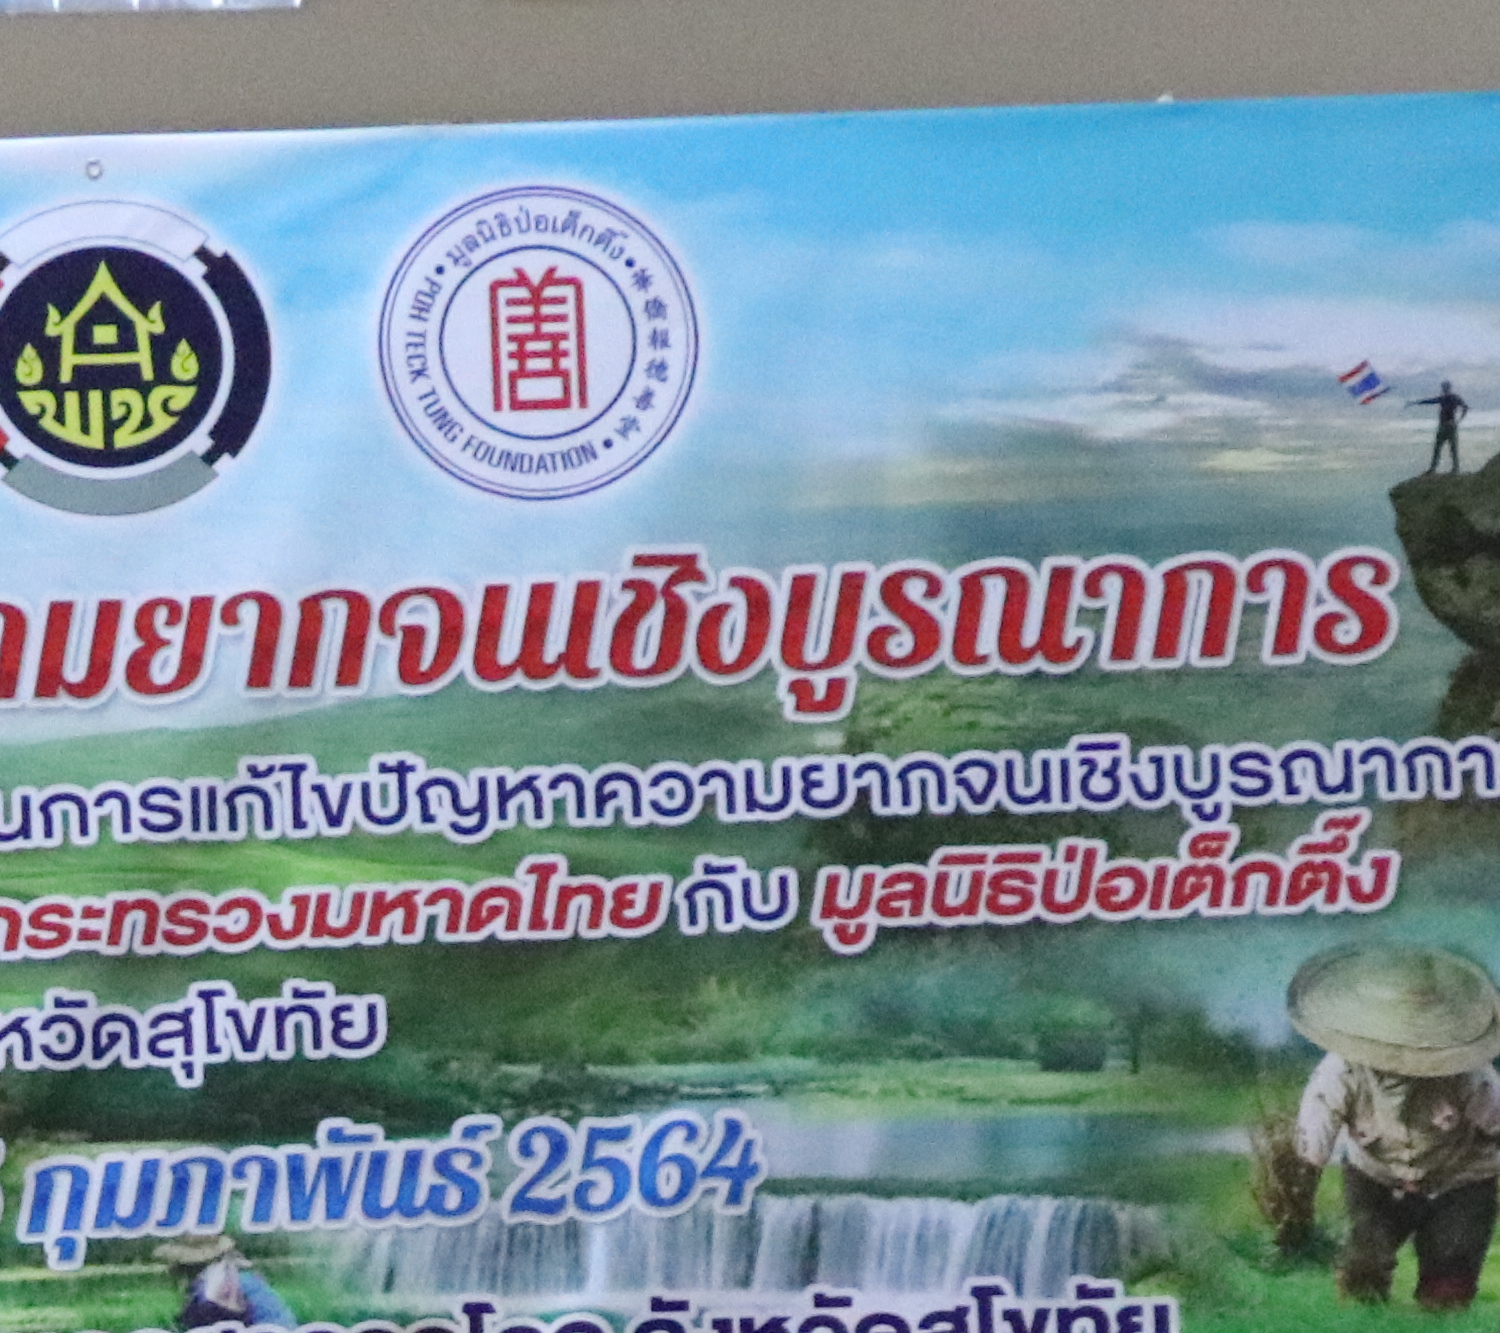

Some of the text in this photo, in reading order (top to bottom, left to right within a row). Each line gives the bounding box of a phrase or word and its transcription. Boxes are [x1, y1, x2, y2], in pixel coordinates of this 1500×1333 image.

[406, 274, 599, 476] POH TECK TUNG FOUNDATION
[683, 863, 789, 926] กับ
[822, 818, 1390, 945] มูลนิธิป่อเต็กตึ๊ง
[26, 1123, 495, 1262] กุมภาพันธ์
[511, 1118, 761, 1216] 2564
